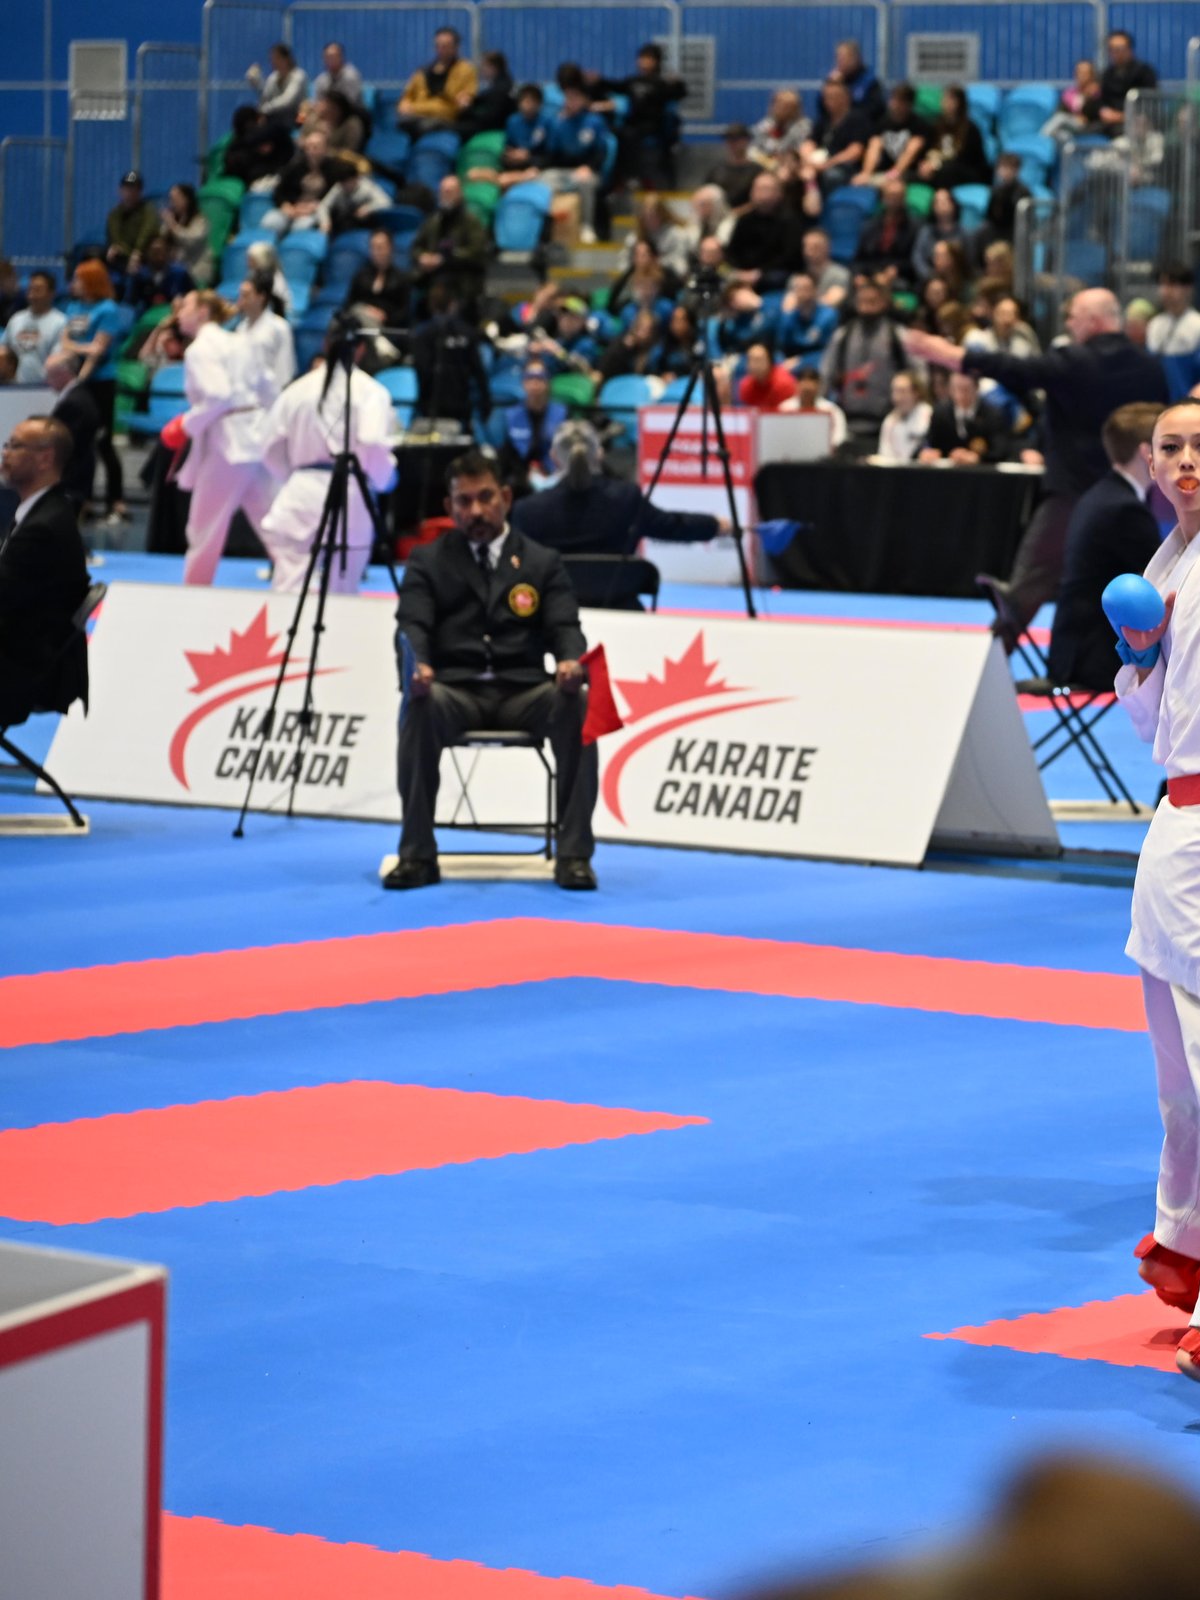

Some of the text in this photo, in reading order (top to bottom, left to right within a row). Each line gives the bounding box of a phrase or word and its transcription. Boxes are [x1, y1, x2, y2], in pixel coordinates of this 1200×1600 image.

[229, 707, 366, 748] KARATE
[215, 747, 349, 788] CANADA
[667, 738, 818, 782] KARATE
[654, 780, 802, 824] CANADA
